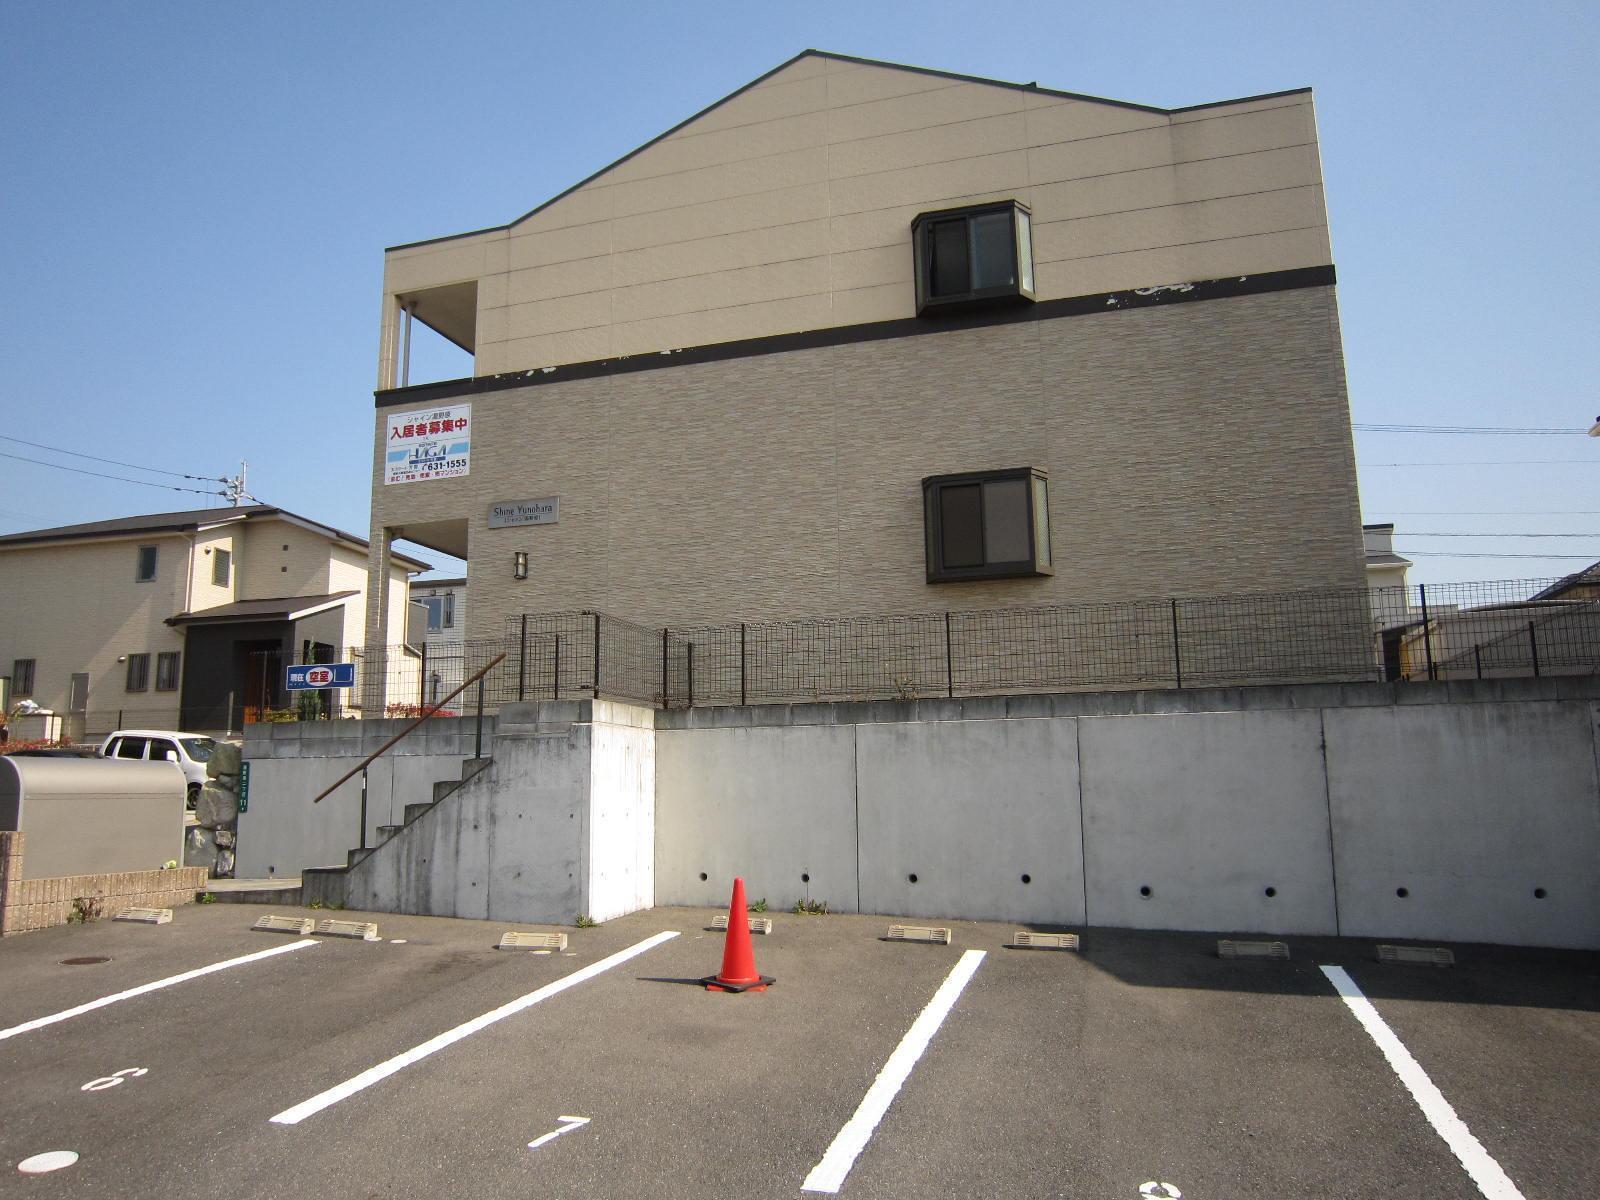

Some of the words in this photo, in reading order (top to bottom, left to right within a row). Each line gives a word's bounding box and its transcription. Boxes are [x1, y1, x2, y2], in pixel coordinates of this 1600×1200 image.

[391, 418, 467, 440] 入居者募集中
[428, 459, 467, 471] 631-1555
[494, 507, 514, 516] Shine
[309, 671, 329, 682] 空室
[81, 1067, 148, 1090] 6
[528, 1116, 591, 1147] 7
